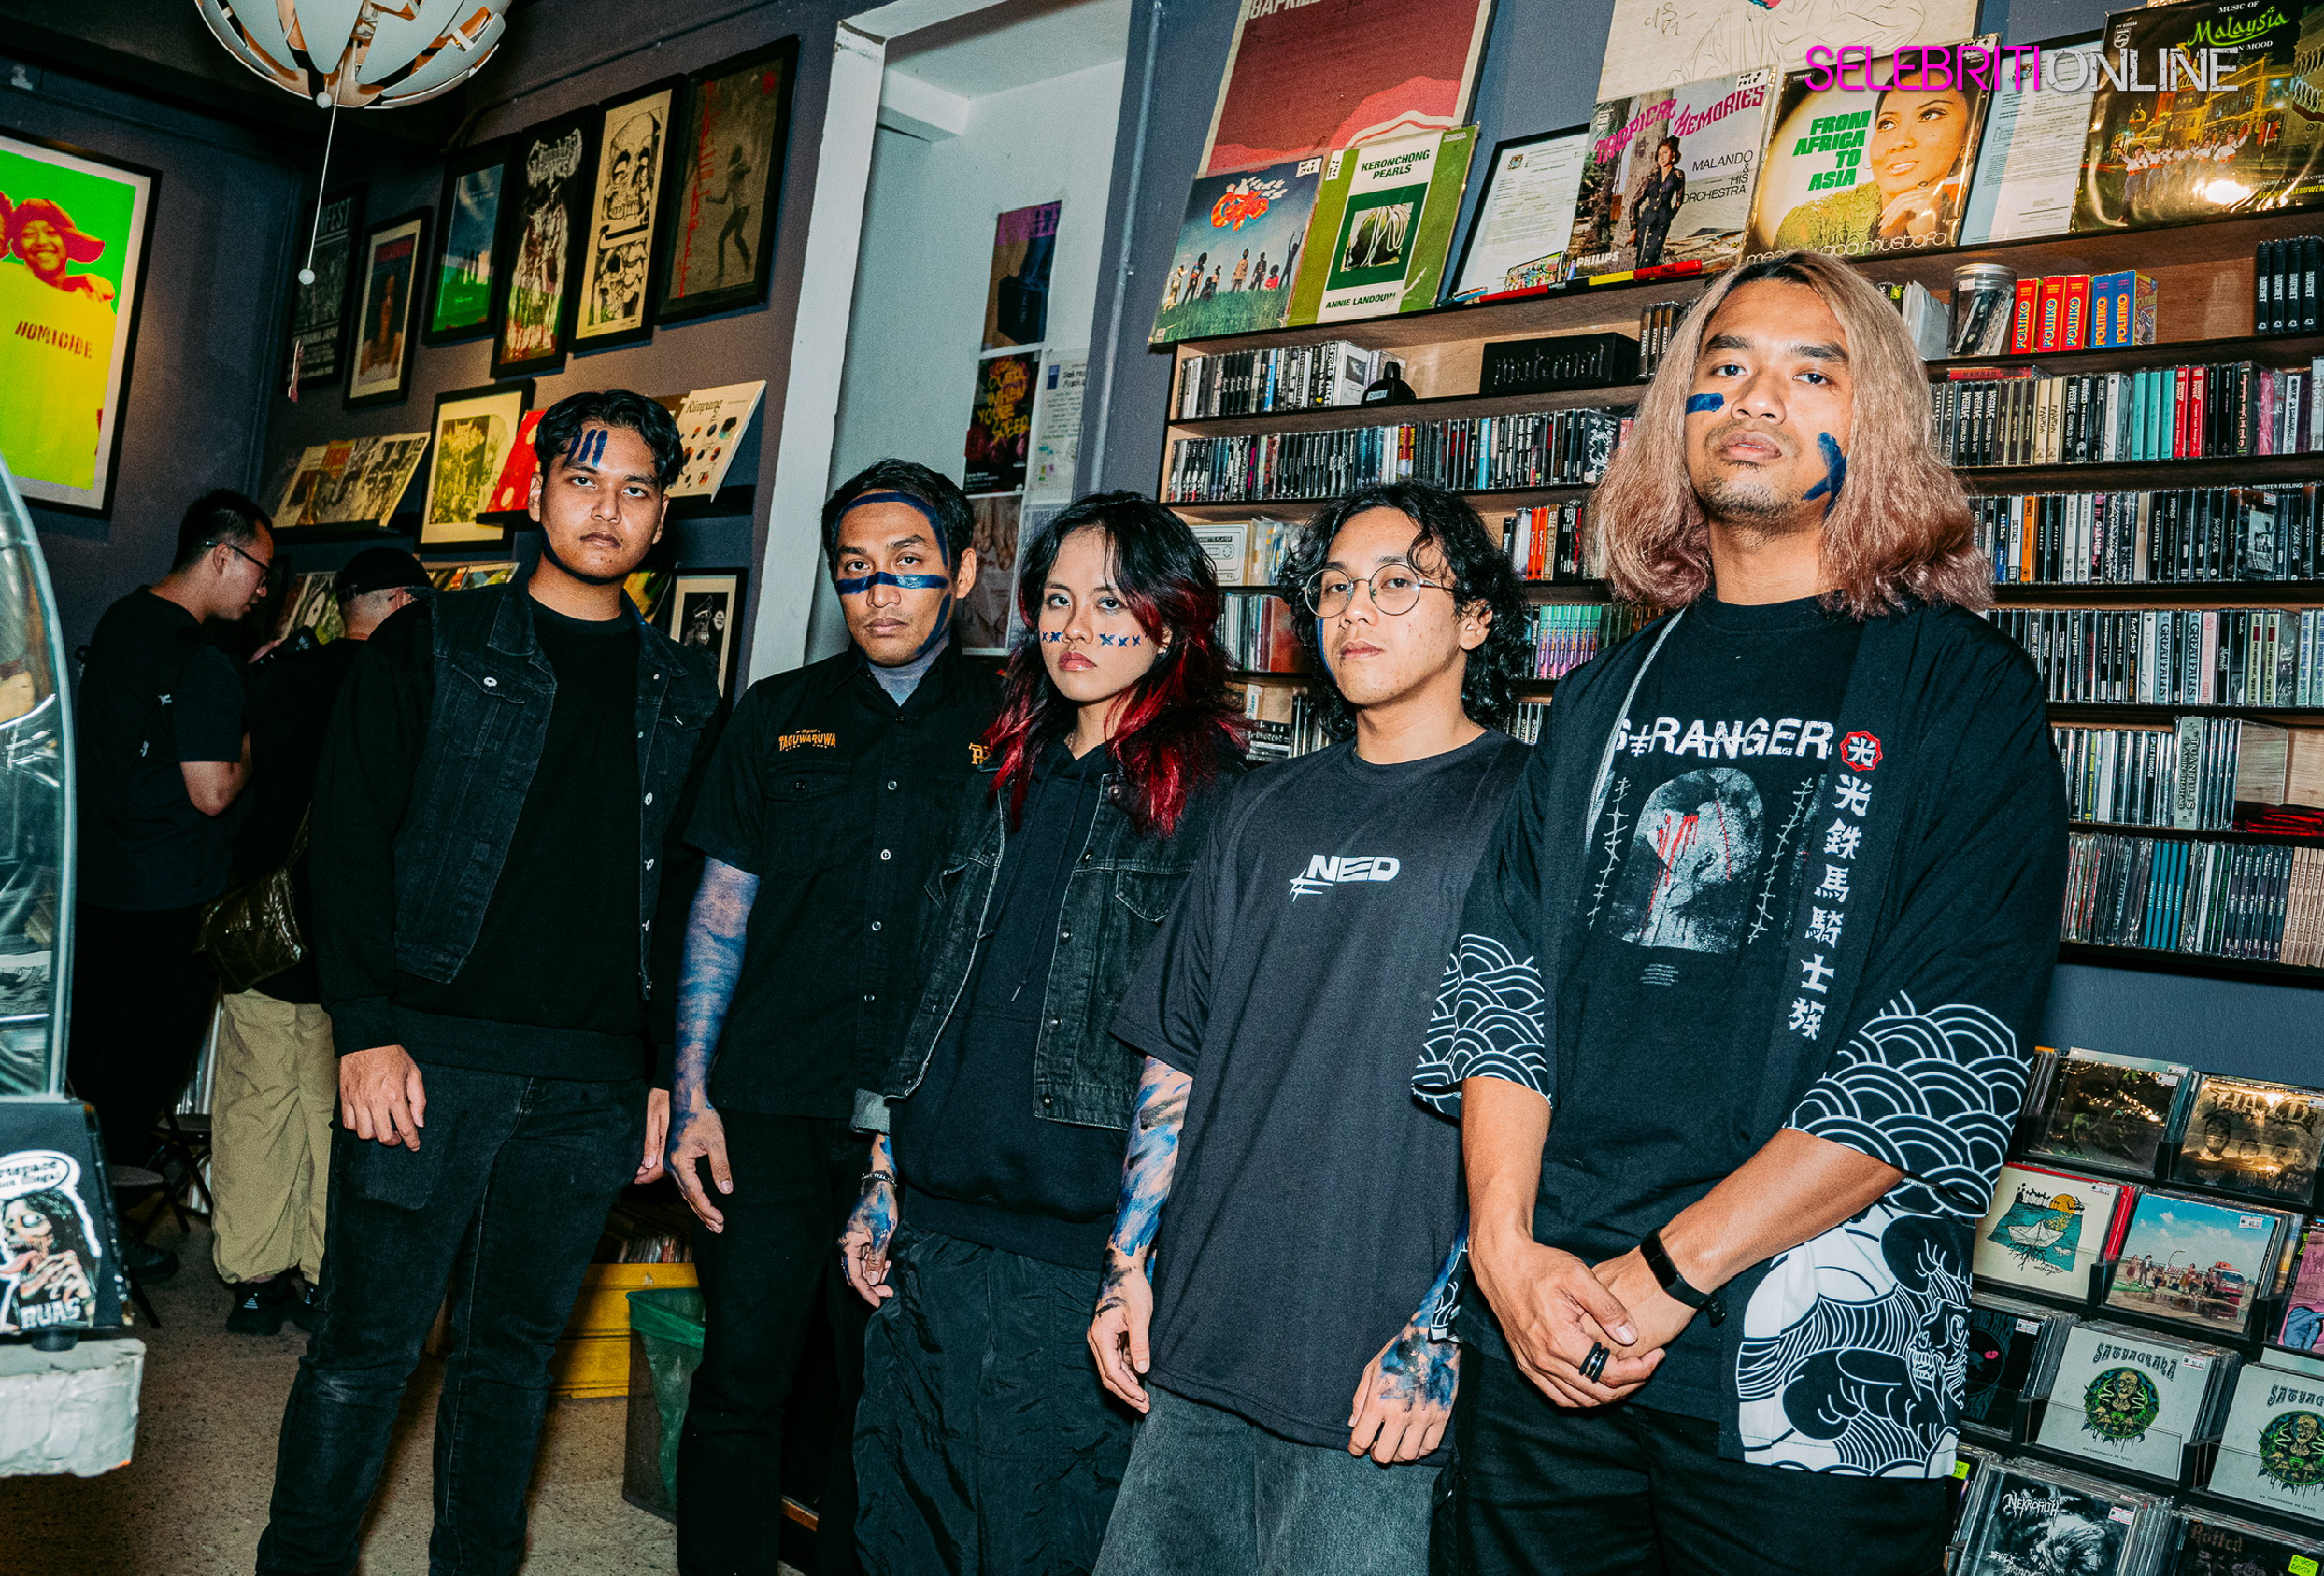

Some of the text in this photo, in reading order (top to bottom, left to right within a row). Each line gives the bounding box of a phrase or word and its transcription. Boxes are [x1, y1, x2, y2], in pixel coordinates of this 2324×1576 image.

[2218, 3, 2246, 13] MUSIC
[2246, 40, 2273, 50] MOOD
[1594, 85, 1765, 164] TROPICAL MEMORIES
[1810, 110, 1872, 135] FROM
[1792, 130, 1865, 157] AFRICA
[1361, 149, 1430, 172] KERONCHONG
[1692, 150, 1753, 172] MALANDO
[1742, 163, 1749, 173] &
[1835, 149, 1862, 169] TO
[1373, 164, 1412, 179] PEARLS
[1729, 173, 1749, 184] HIS
[1807, 168, 1857, 191] ASIA
[1682, 185, 1746, 204] ORCHESTRA
[1867, 231, 1946, 255] mustafa
[1575, 251, 1619, 267] PHILIPS
[1325, 298, 1350, 309] ANNIE
[2016, 301, 2031, 348] POLITIKO
[2043, 298, 2058, 348] POLITIKO
[2065, 297, 2081, 346] POLITIKO
[2096, 296, 2108, 346] POLITIKO
[2117, 293, 2129, 344] POLITIKO
[15, 320, 93, 360] HOMICIDE
[1324, 380, 1333, 405] PEACE
[2093, 1342, 2178, 1382] SATYAGRAHA
